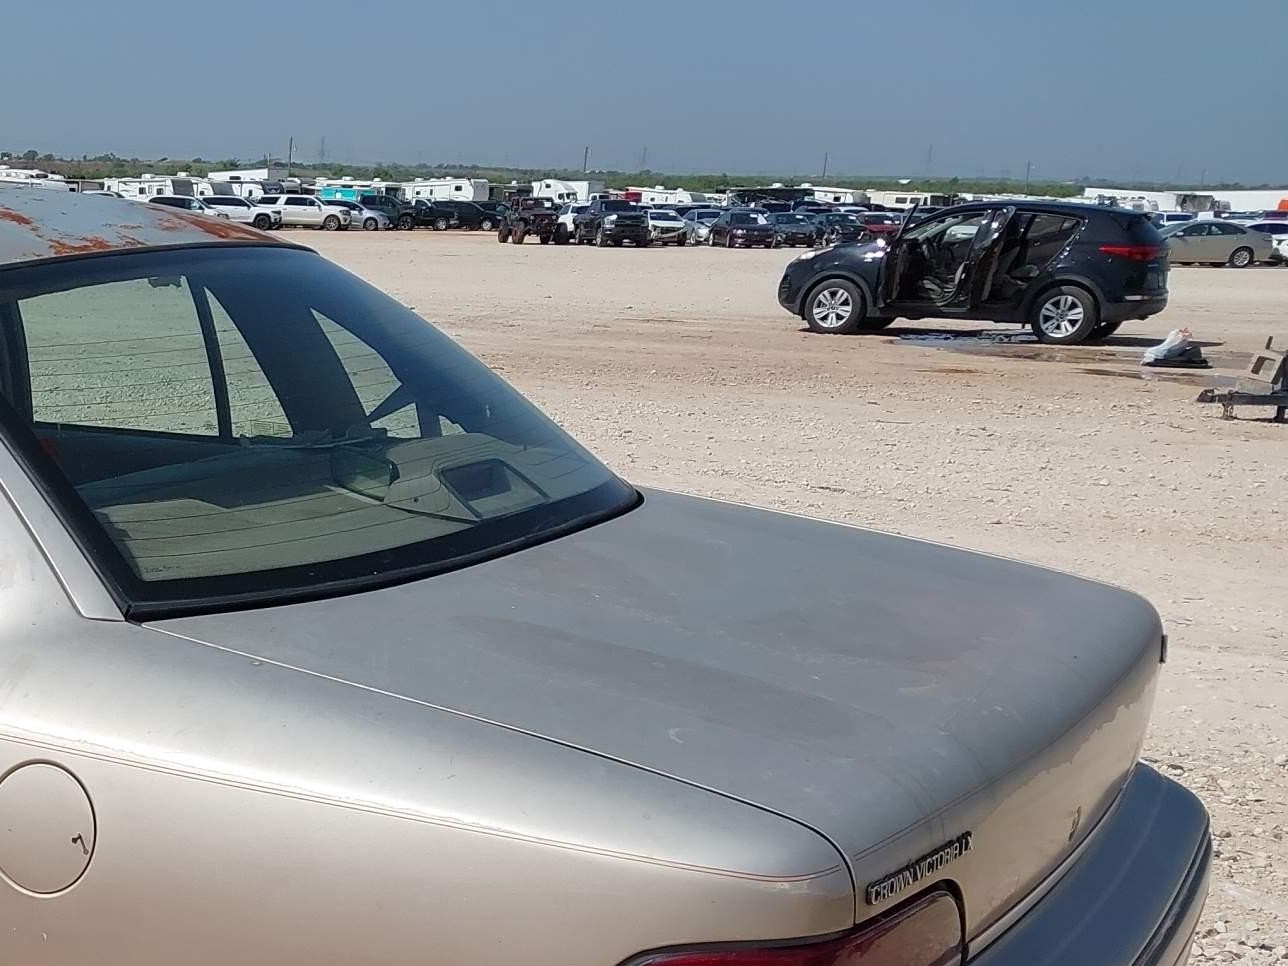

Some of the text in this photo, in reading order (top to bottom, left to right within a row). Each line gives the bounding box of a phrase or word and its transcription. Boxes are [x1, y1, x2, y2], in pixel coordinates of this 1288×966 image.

[870, 831, 974, 905] CROWN VICTORIA LX
